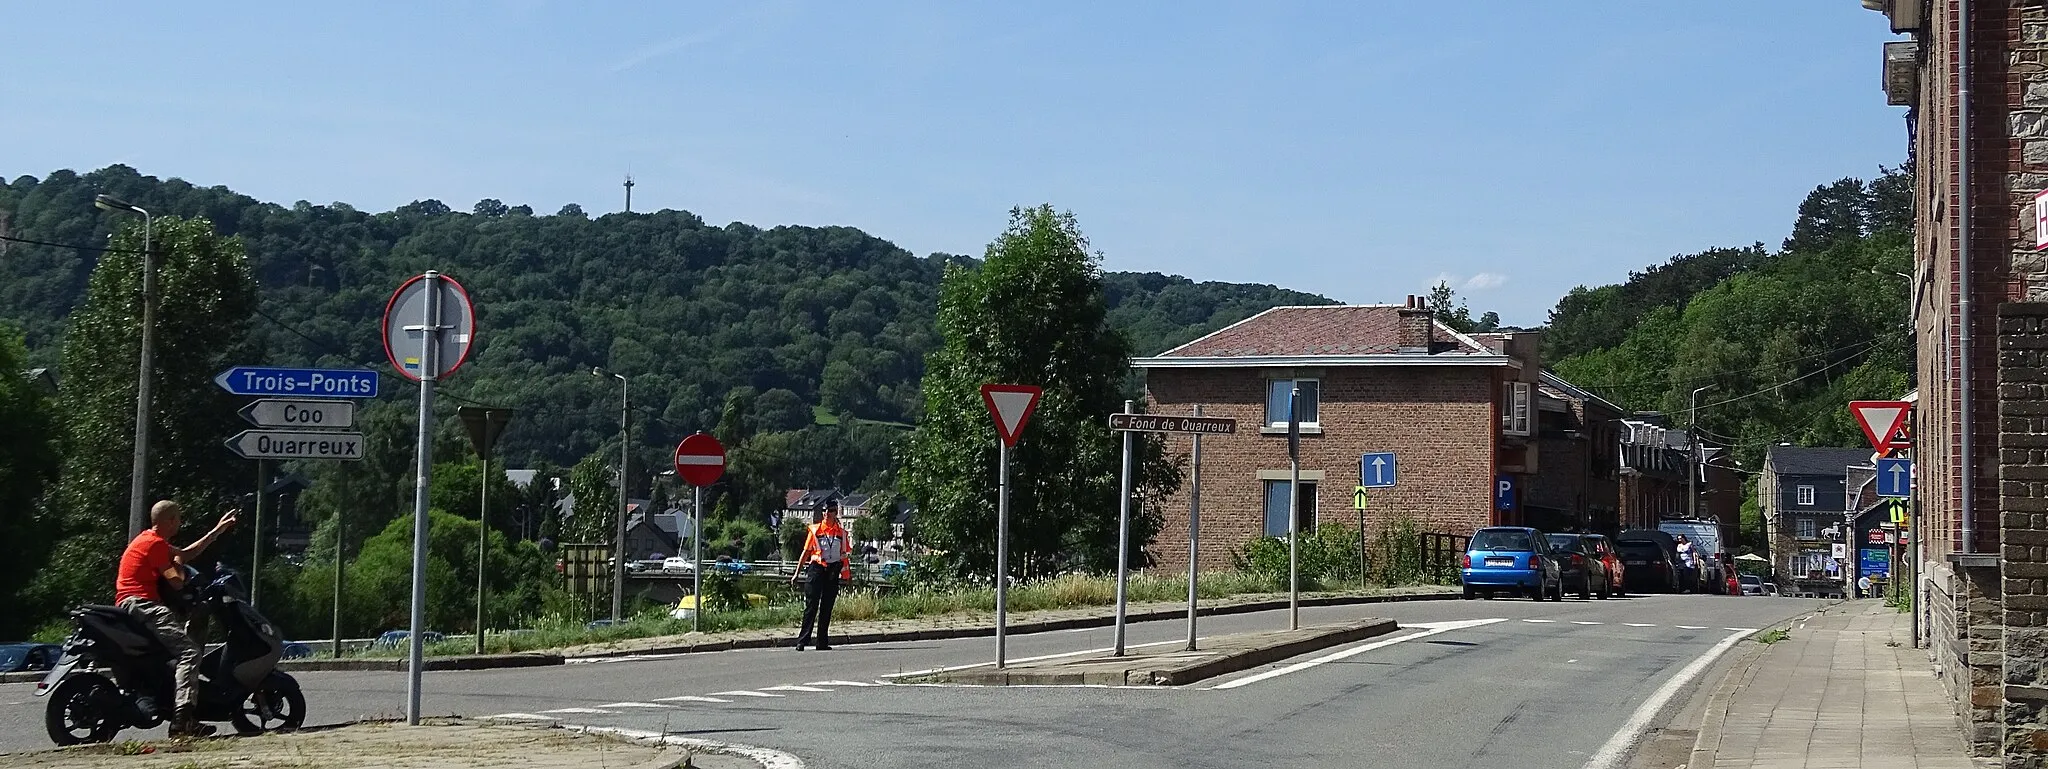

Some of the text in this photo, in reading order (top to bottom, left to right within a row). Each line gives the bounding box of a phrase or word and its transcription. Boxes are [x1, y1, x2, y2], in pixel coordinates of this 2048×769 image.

[243, 371, 371, 393] Trois-Ponts
[284, 404, 323, 423] Coo
[1129, 416, 1231, 433] Fond de Quarreux
[257, 435, 356, 456] Quarreux
[1499, 480, 1511, 498] P
